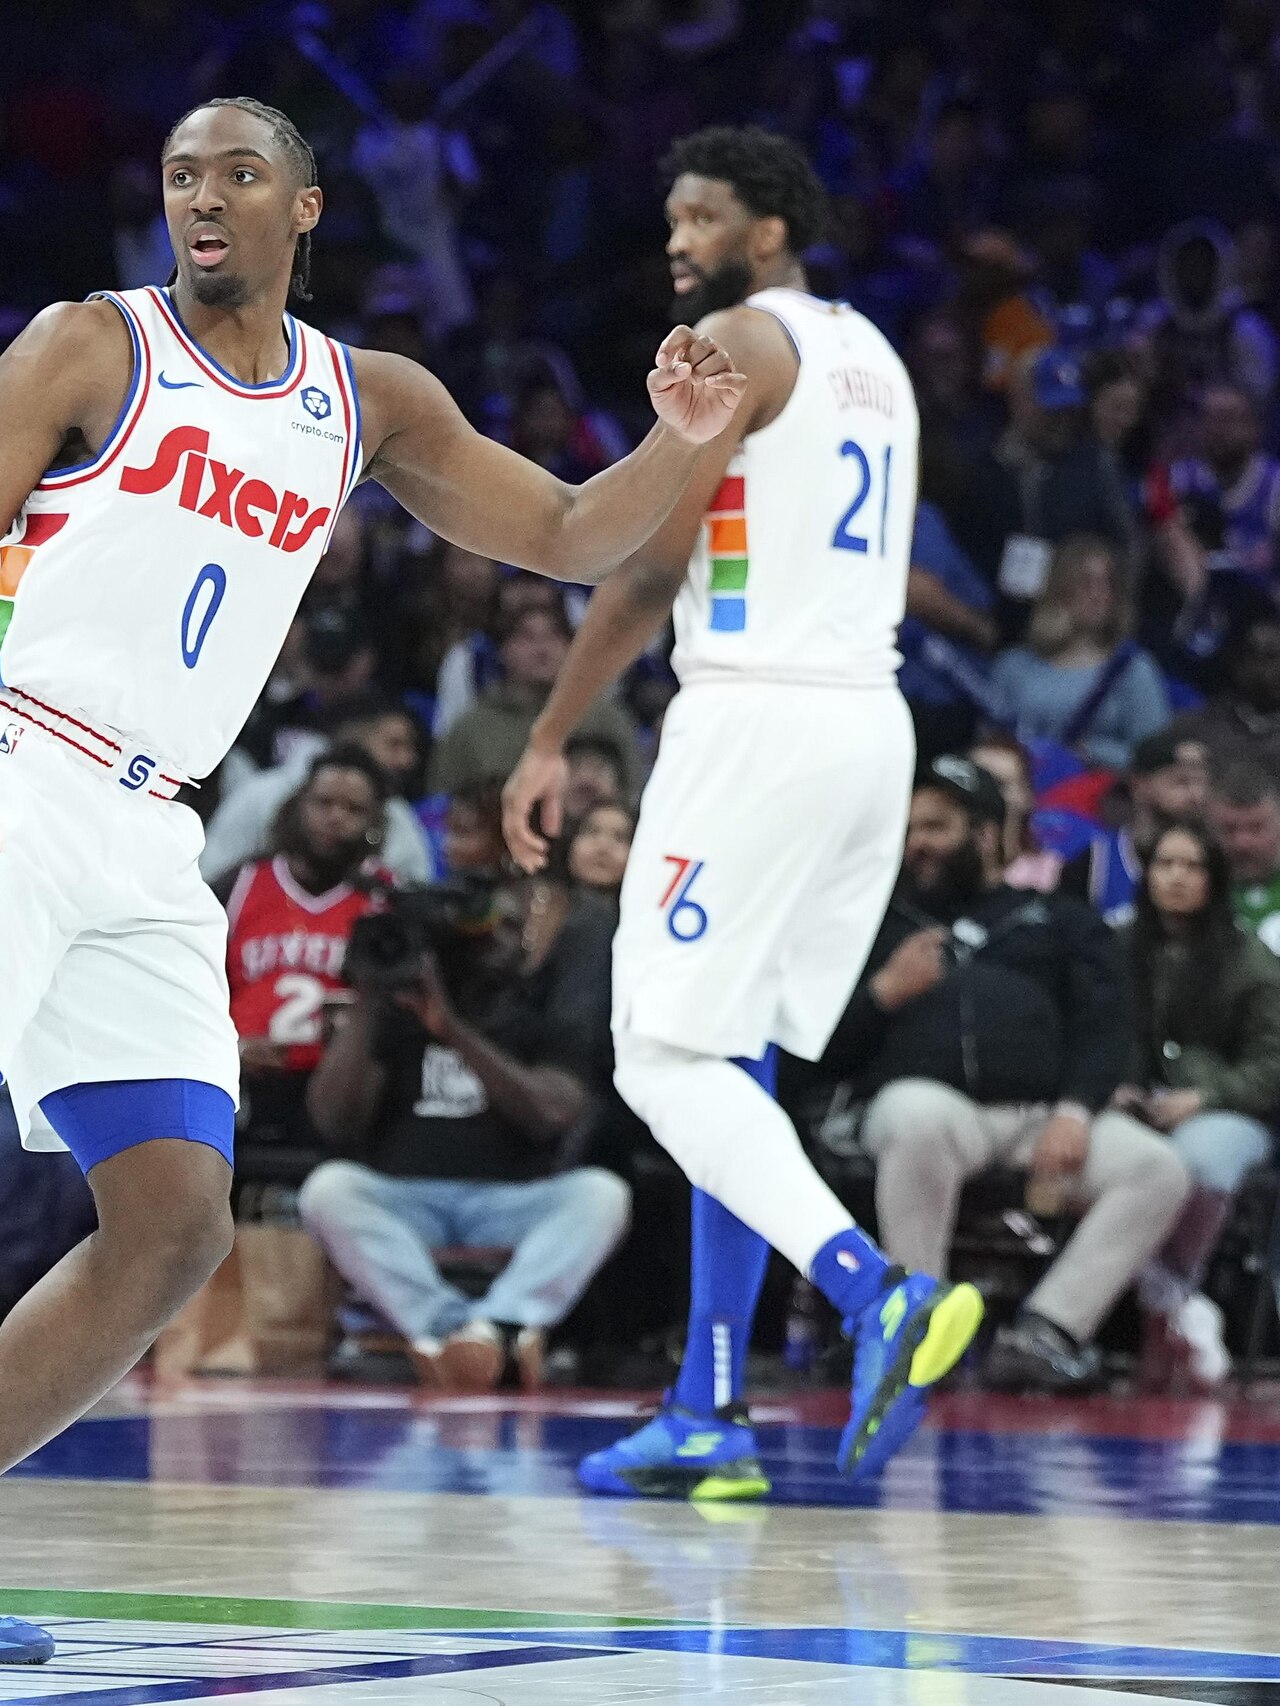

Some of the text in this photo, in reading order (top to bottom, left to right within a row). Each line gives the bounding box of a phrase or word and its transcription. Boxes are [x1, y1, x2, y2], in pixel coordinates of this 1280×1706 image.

[290, 421, 344, 444] crypto.com
[118, 425, 331, 553] Sixers
[832, 439, 892, 557] 21
[181, 563, 227, 669] 0
[659, 856, 708, 942] 76
